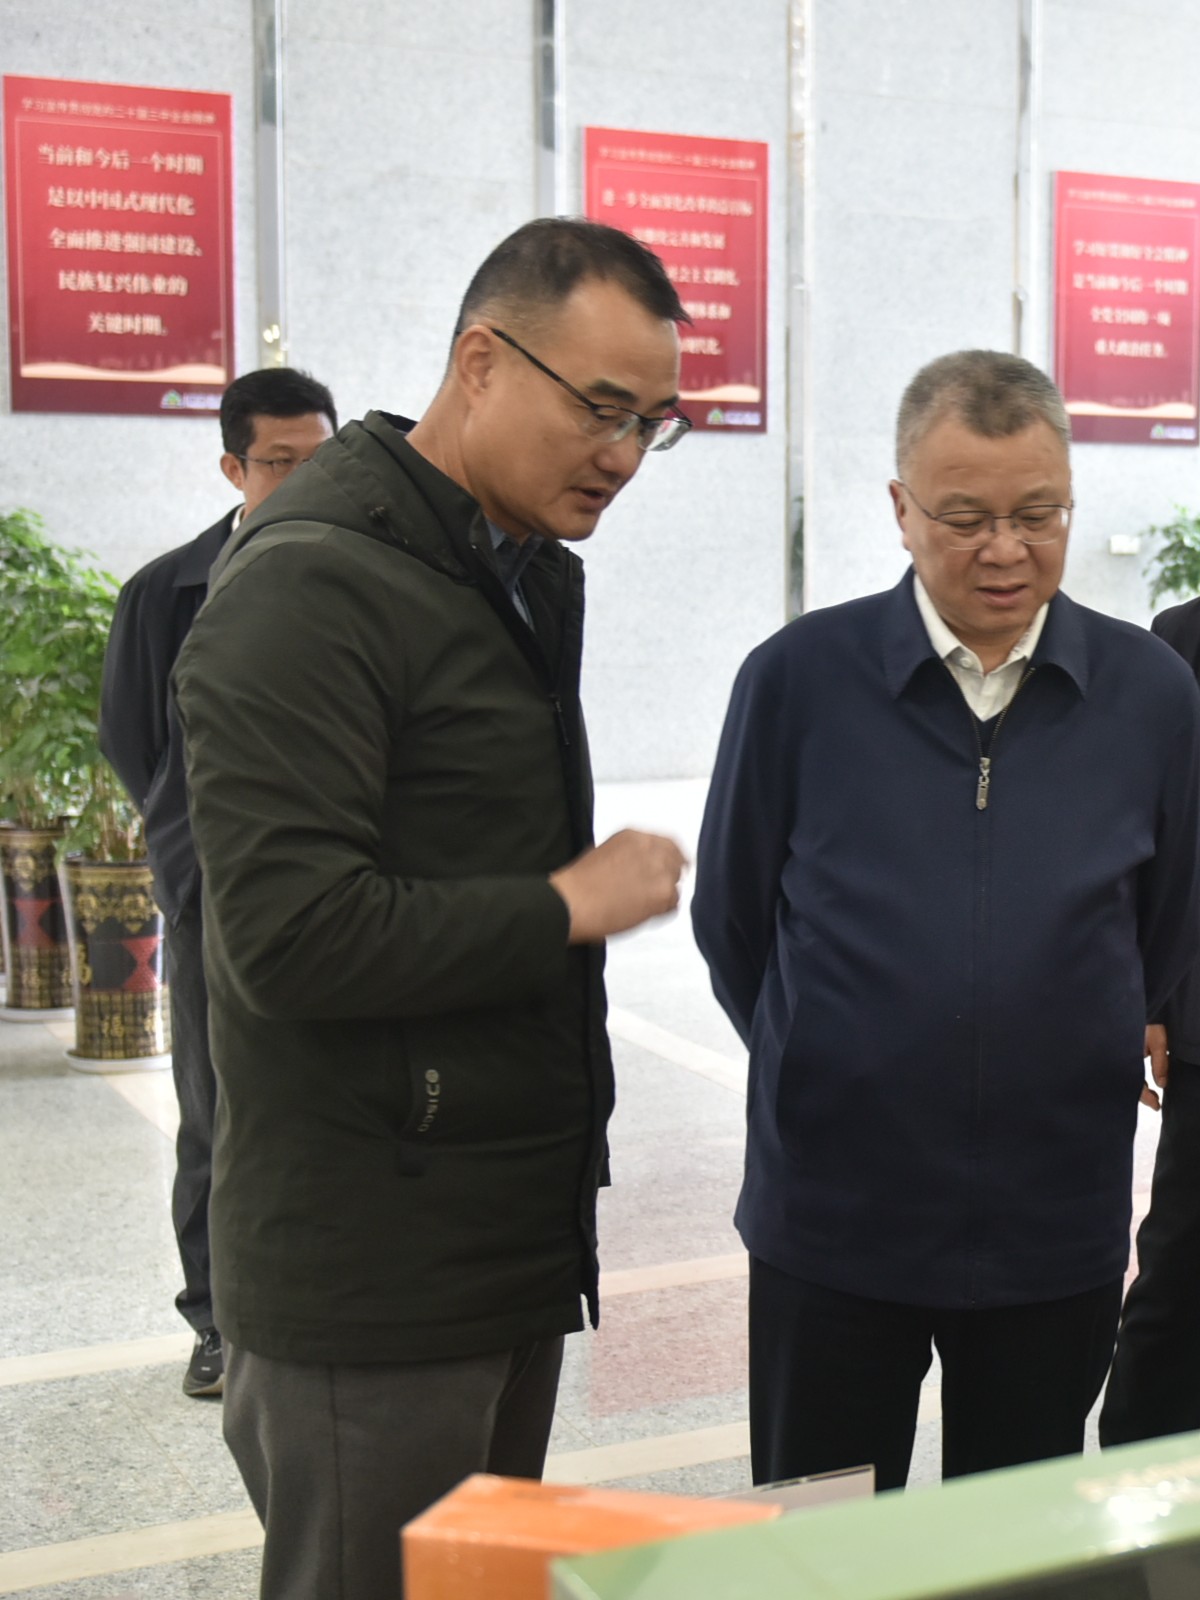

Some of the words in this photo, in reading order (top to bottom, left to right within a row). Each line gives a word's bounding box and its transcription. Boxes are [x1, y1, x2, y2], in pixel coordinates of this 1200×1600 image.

[38, 143, 205, 176] 当前和今后一个时期
[48, 186, 197, 217] 是以中国式现代化
[59, 269, 189, 297] 民族复兴伟业的
[88, 312, 169, 336] 关键时期。
